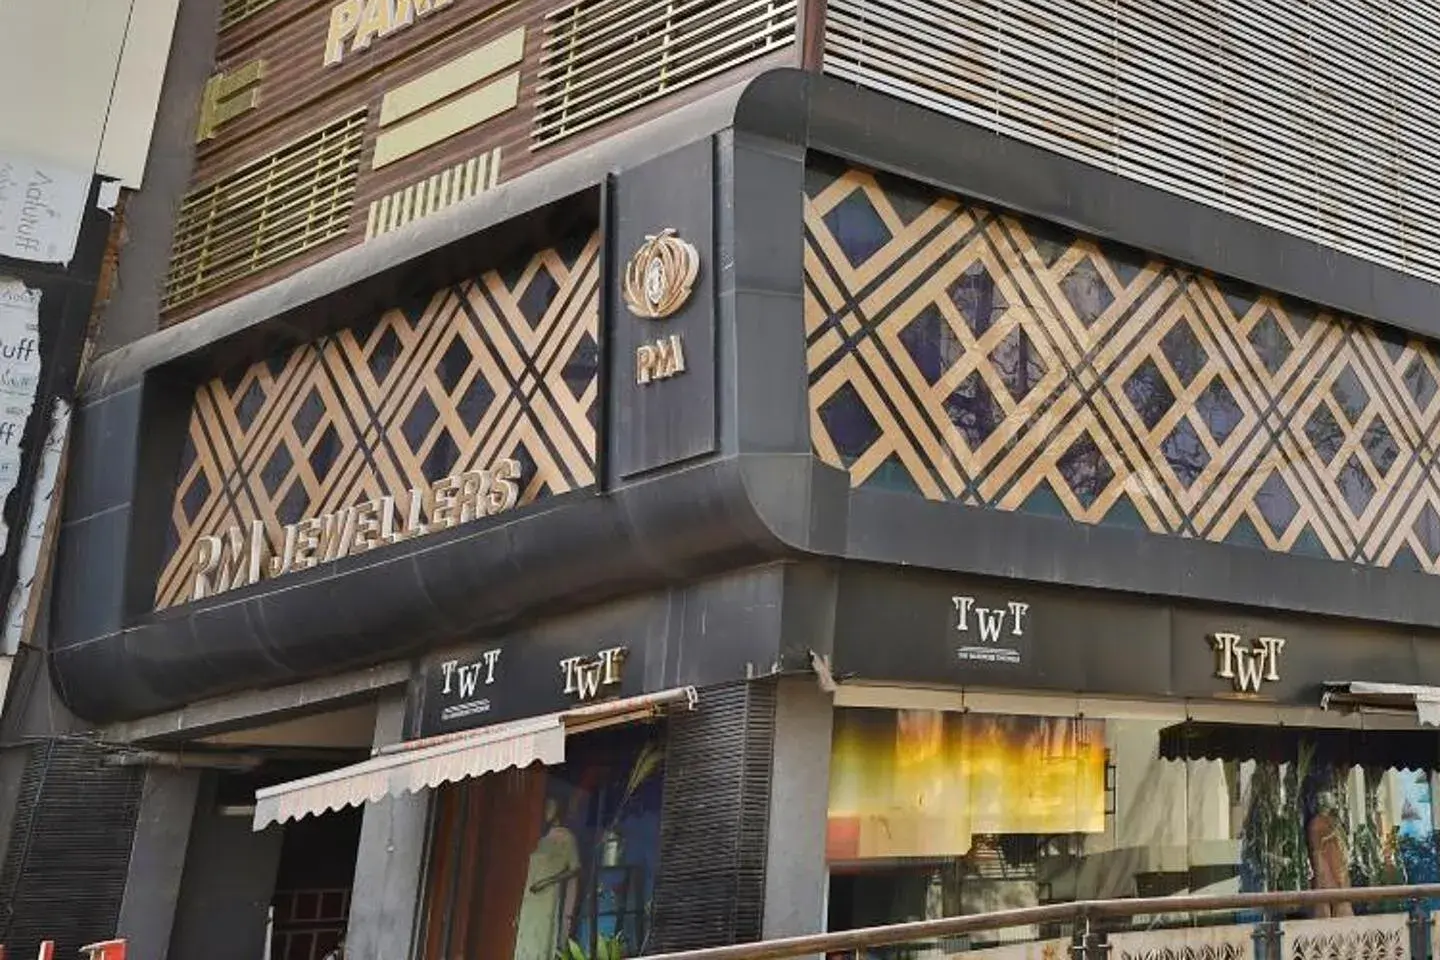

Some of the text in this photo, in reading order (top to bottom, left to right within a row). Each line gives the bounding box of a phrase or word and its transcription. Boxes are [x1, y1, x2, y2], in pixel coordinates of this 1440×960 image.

[269, 457, 522, 578] JEWELLERS
[952, 596, 1030, 642] TWT
[441, 648, 502, 699] TWT
[559, 645, 626, 700] TWT
[1214, 632, 1286, 692] TWT
